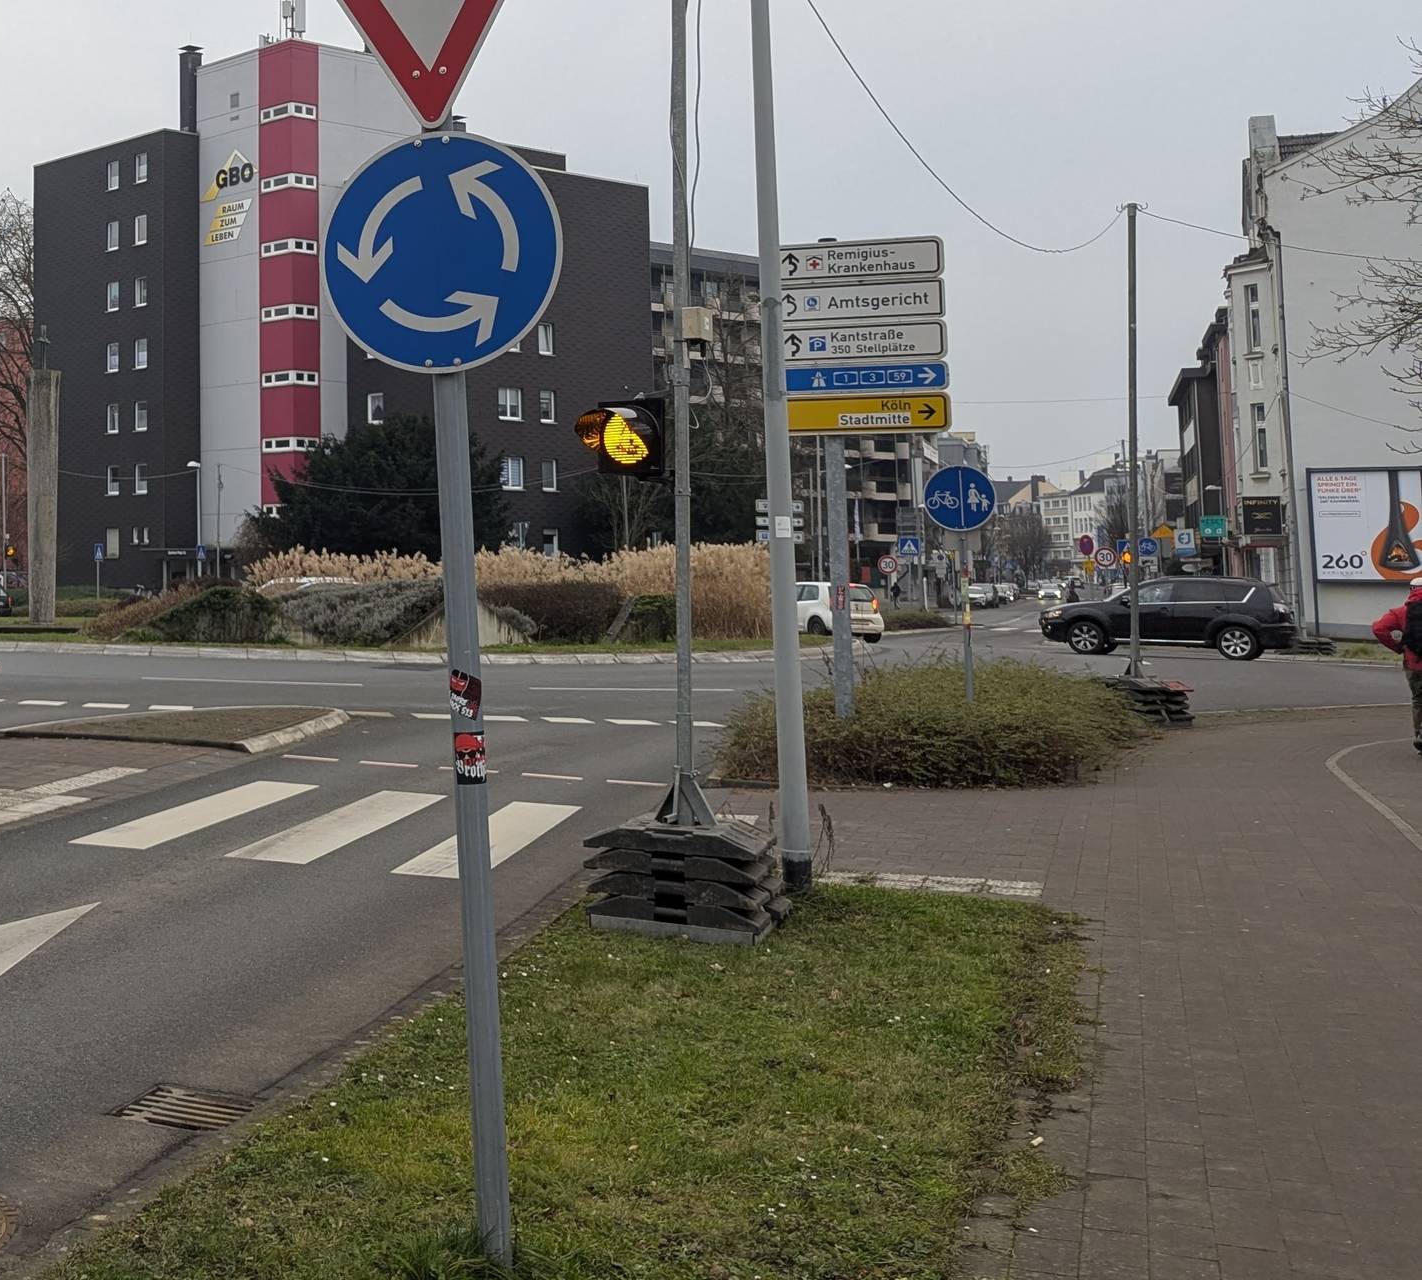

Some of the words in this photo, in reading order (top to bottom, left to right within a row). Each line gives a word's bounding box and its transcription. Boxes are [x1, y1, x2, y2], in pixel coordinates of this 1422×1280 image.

[215, 162, 254, 189] GBO
[221, 202, 245, 214] RAUM
[219, 216, 237, 227] ZUM
[211, 230, 234, 242] LEBEN
[827, 248, 896, 262] Remigius-
[827, 260, 916, 274] Krankenhaus
[827, 291, 929, 310] Amtsgericht
[830, 329, 904, 343] Kantstraße
[831, 345, 851, 354] 350
[856, 343, 916, 355] Stellplätze
[869, 373, 876, 381] 3
[893, 372, 906, 381] 59
[881, 400, 911, 411] Köln
[840, 414, 910, 426] Stadtmitte
[1098, 552, 1112, 562] 30
[882, 560, 894, 569] 30
